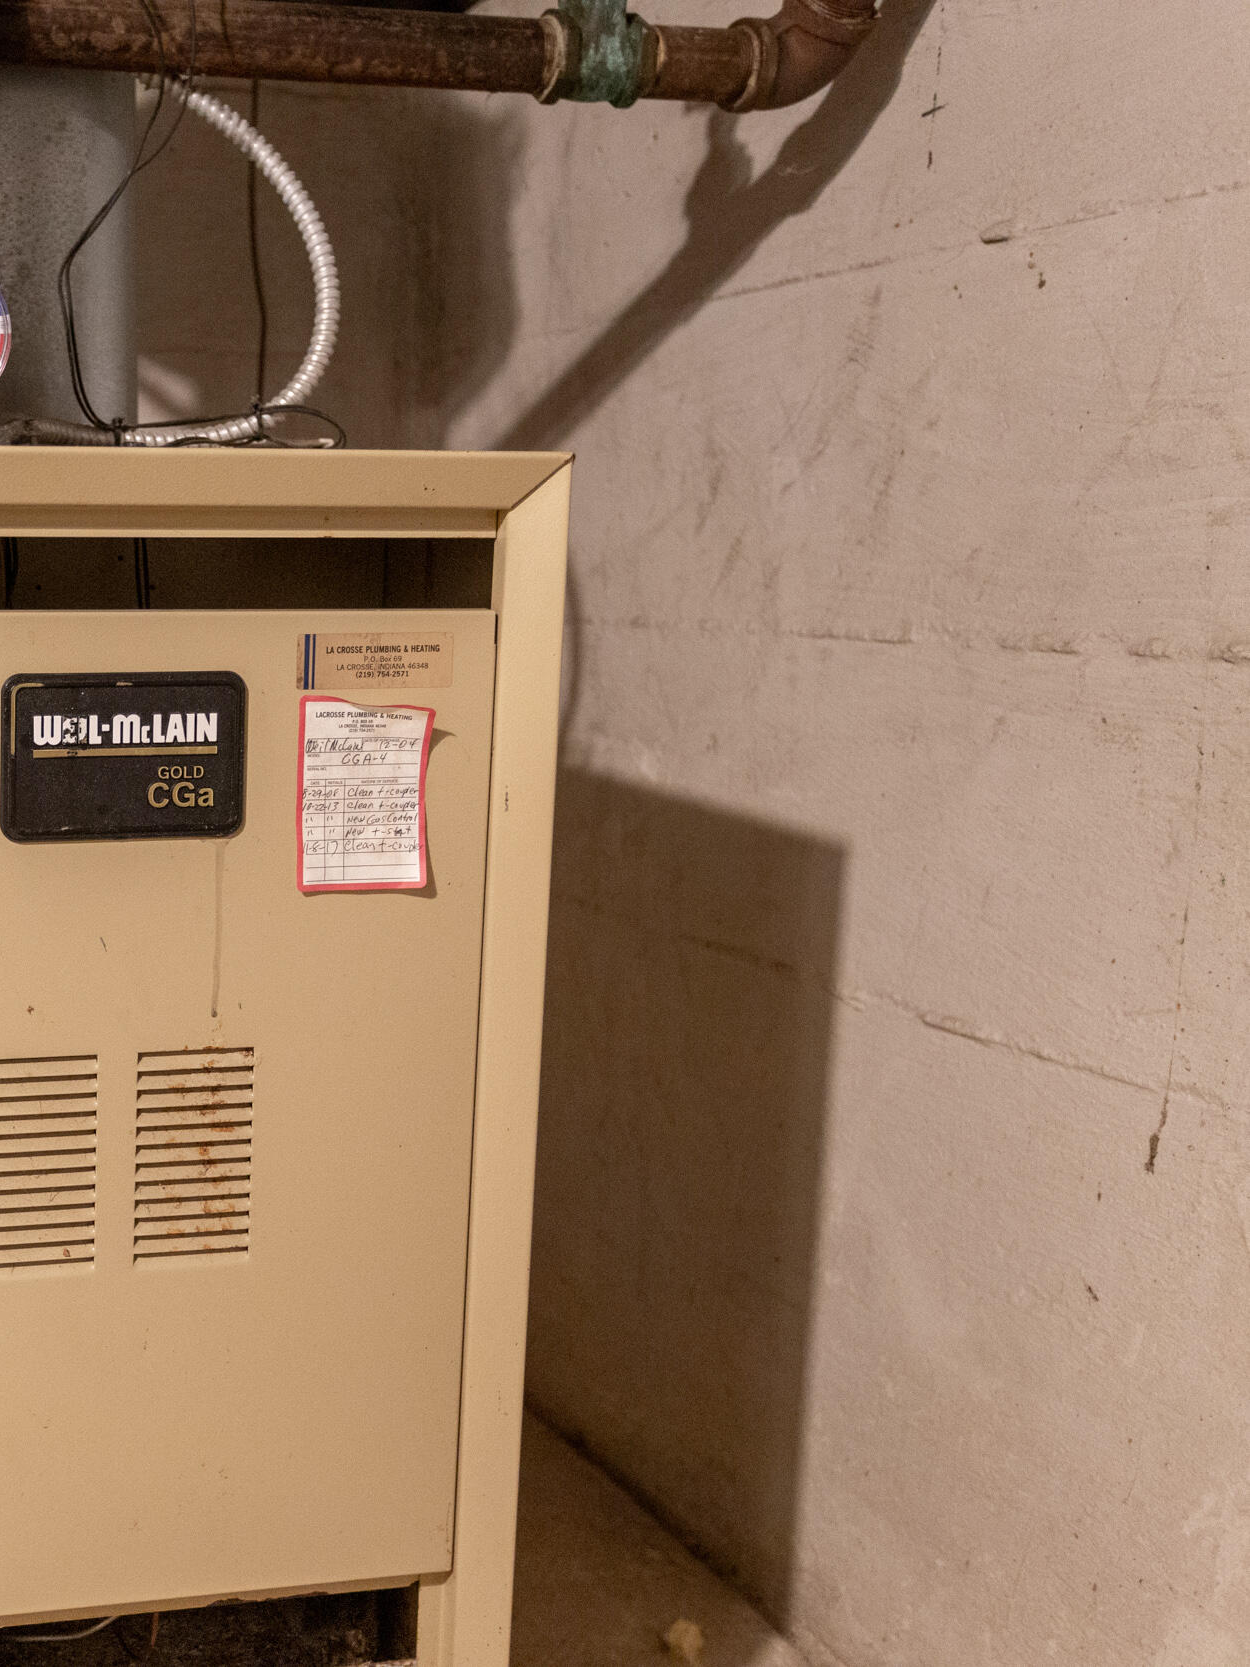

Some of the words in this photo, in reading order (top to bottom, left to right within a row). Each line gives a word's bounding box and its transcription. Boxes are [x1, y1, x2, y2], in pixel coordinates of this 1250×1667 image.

[326, 646, 335, 654] LA
[336, 646, 363, 654] CROSSE
[365, 645, 401, 653] PLUMBING
[403, 645, 409, 653] &
[410, 644, 441, 653] HEATING
[346, 663, 376, 671] CROSSE,
[407, 662, 429, 670] 46348
[315, 711, 346, 719] LACROSSE
[347, 711, 378, 719] PLUMBING
[386, 713, 413, 721] HEATING
[158, 765, 204, 780] GOLD
[147, 782, 214, 808] CGa
